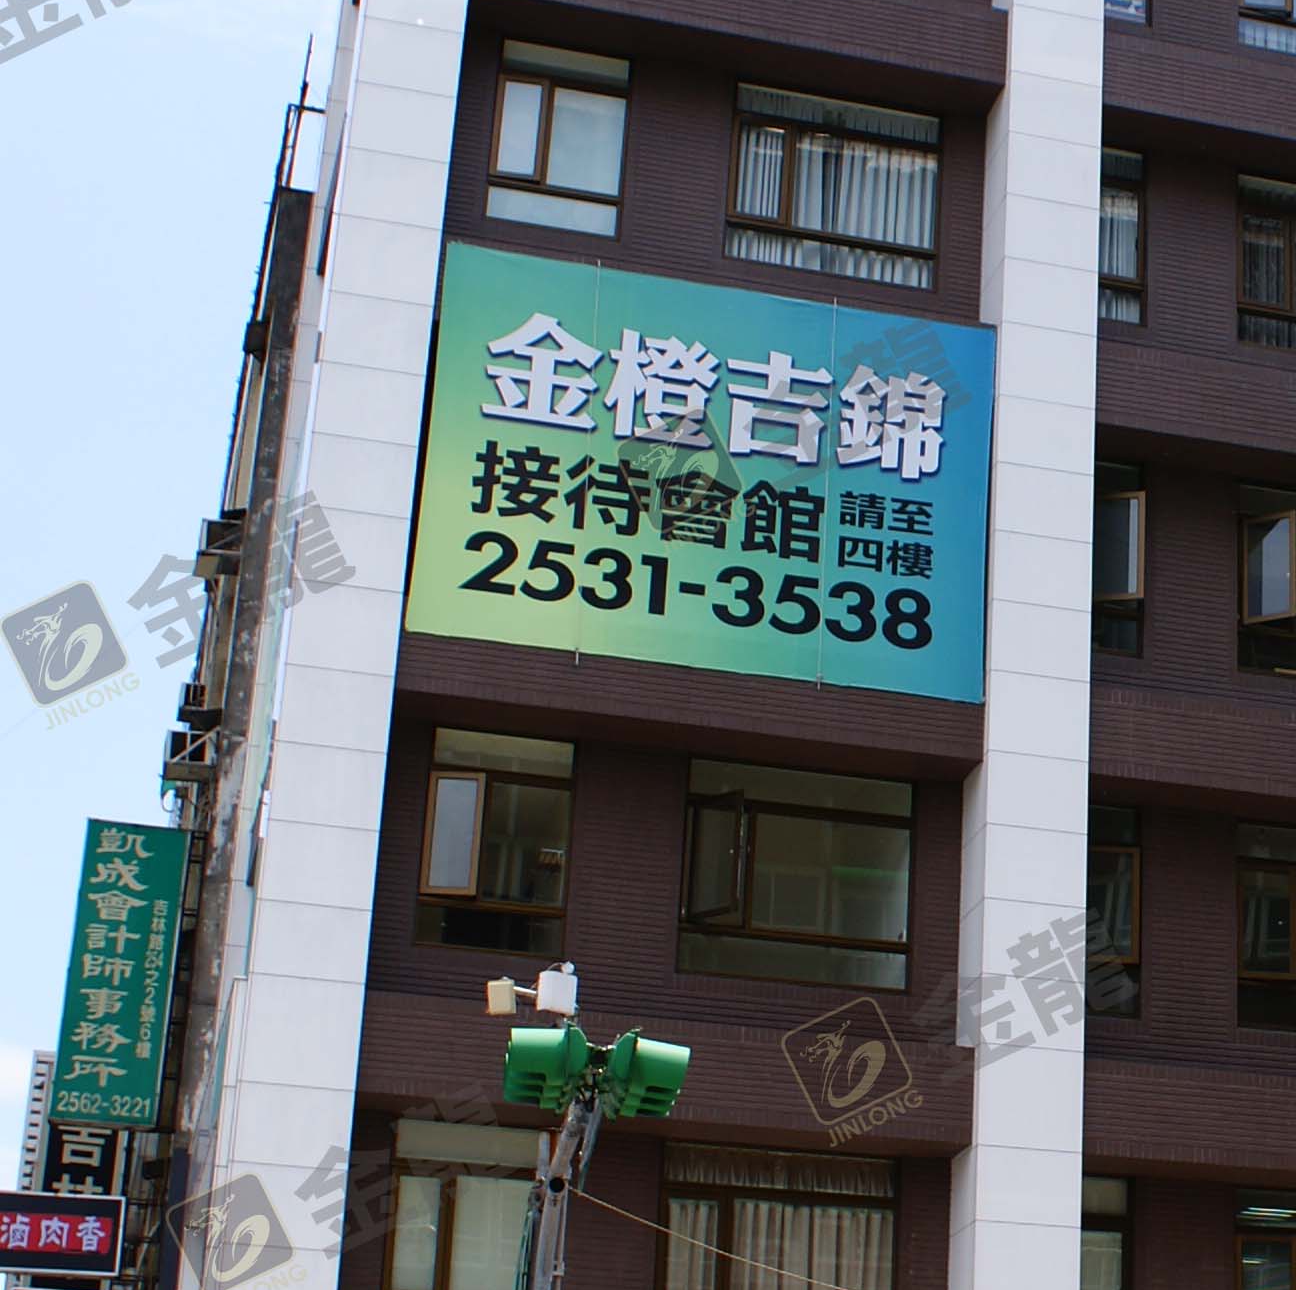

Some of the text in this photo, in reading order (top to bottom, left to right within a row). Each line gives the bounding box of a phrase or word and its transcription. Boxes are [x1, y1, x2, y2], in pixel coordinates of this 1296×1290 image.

[479, 312, 947, 482] 金橙吉錦
[471, 439, 827, 564] 接待會館
[836, 537, 934, 580] 四樓
[838, 490, 935, 537] 請至
[457, 531, 934, 651] 2531-3538
[64, 828, 154, 1088] 凱成會計師事務所
[56, 1091, 150, 1118] 2562-3221
